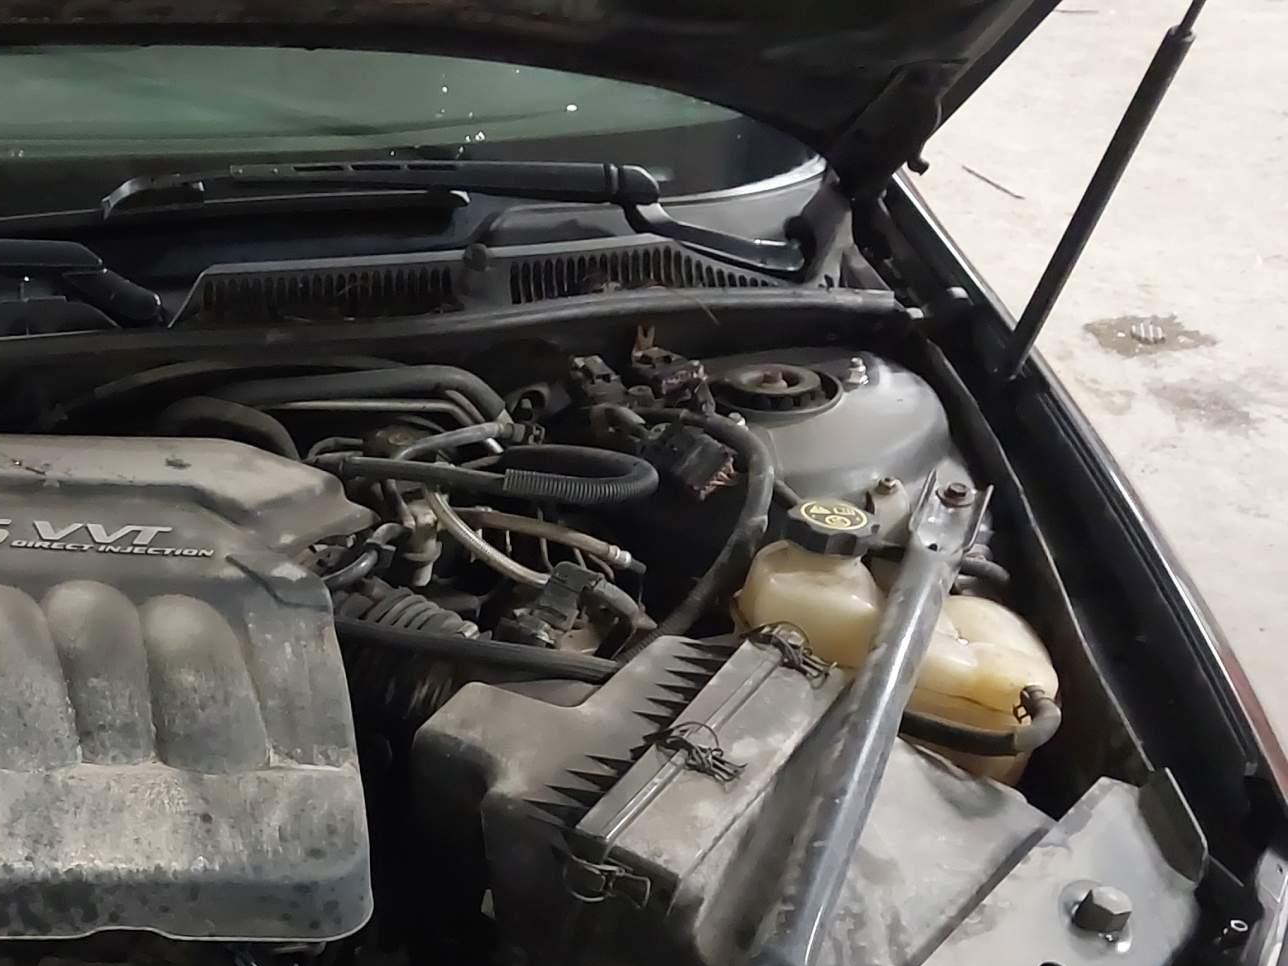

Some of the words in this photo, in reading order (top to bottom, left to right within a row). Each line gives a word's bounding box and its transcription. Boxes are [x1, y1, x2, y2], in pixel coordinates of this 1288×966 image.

[33, 520, 172, 545] VVT
[10, 540, 94, 552] DIRECT
[98, 544, 214, 557] INJECTION
